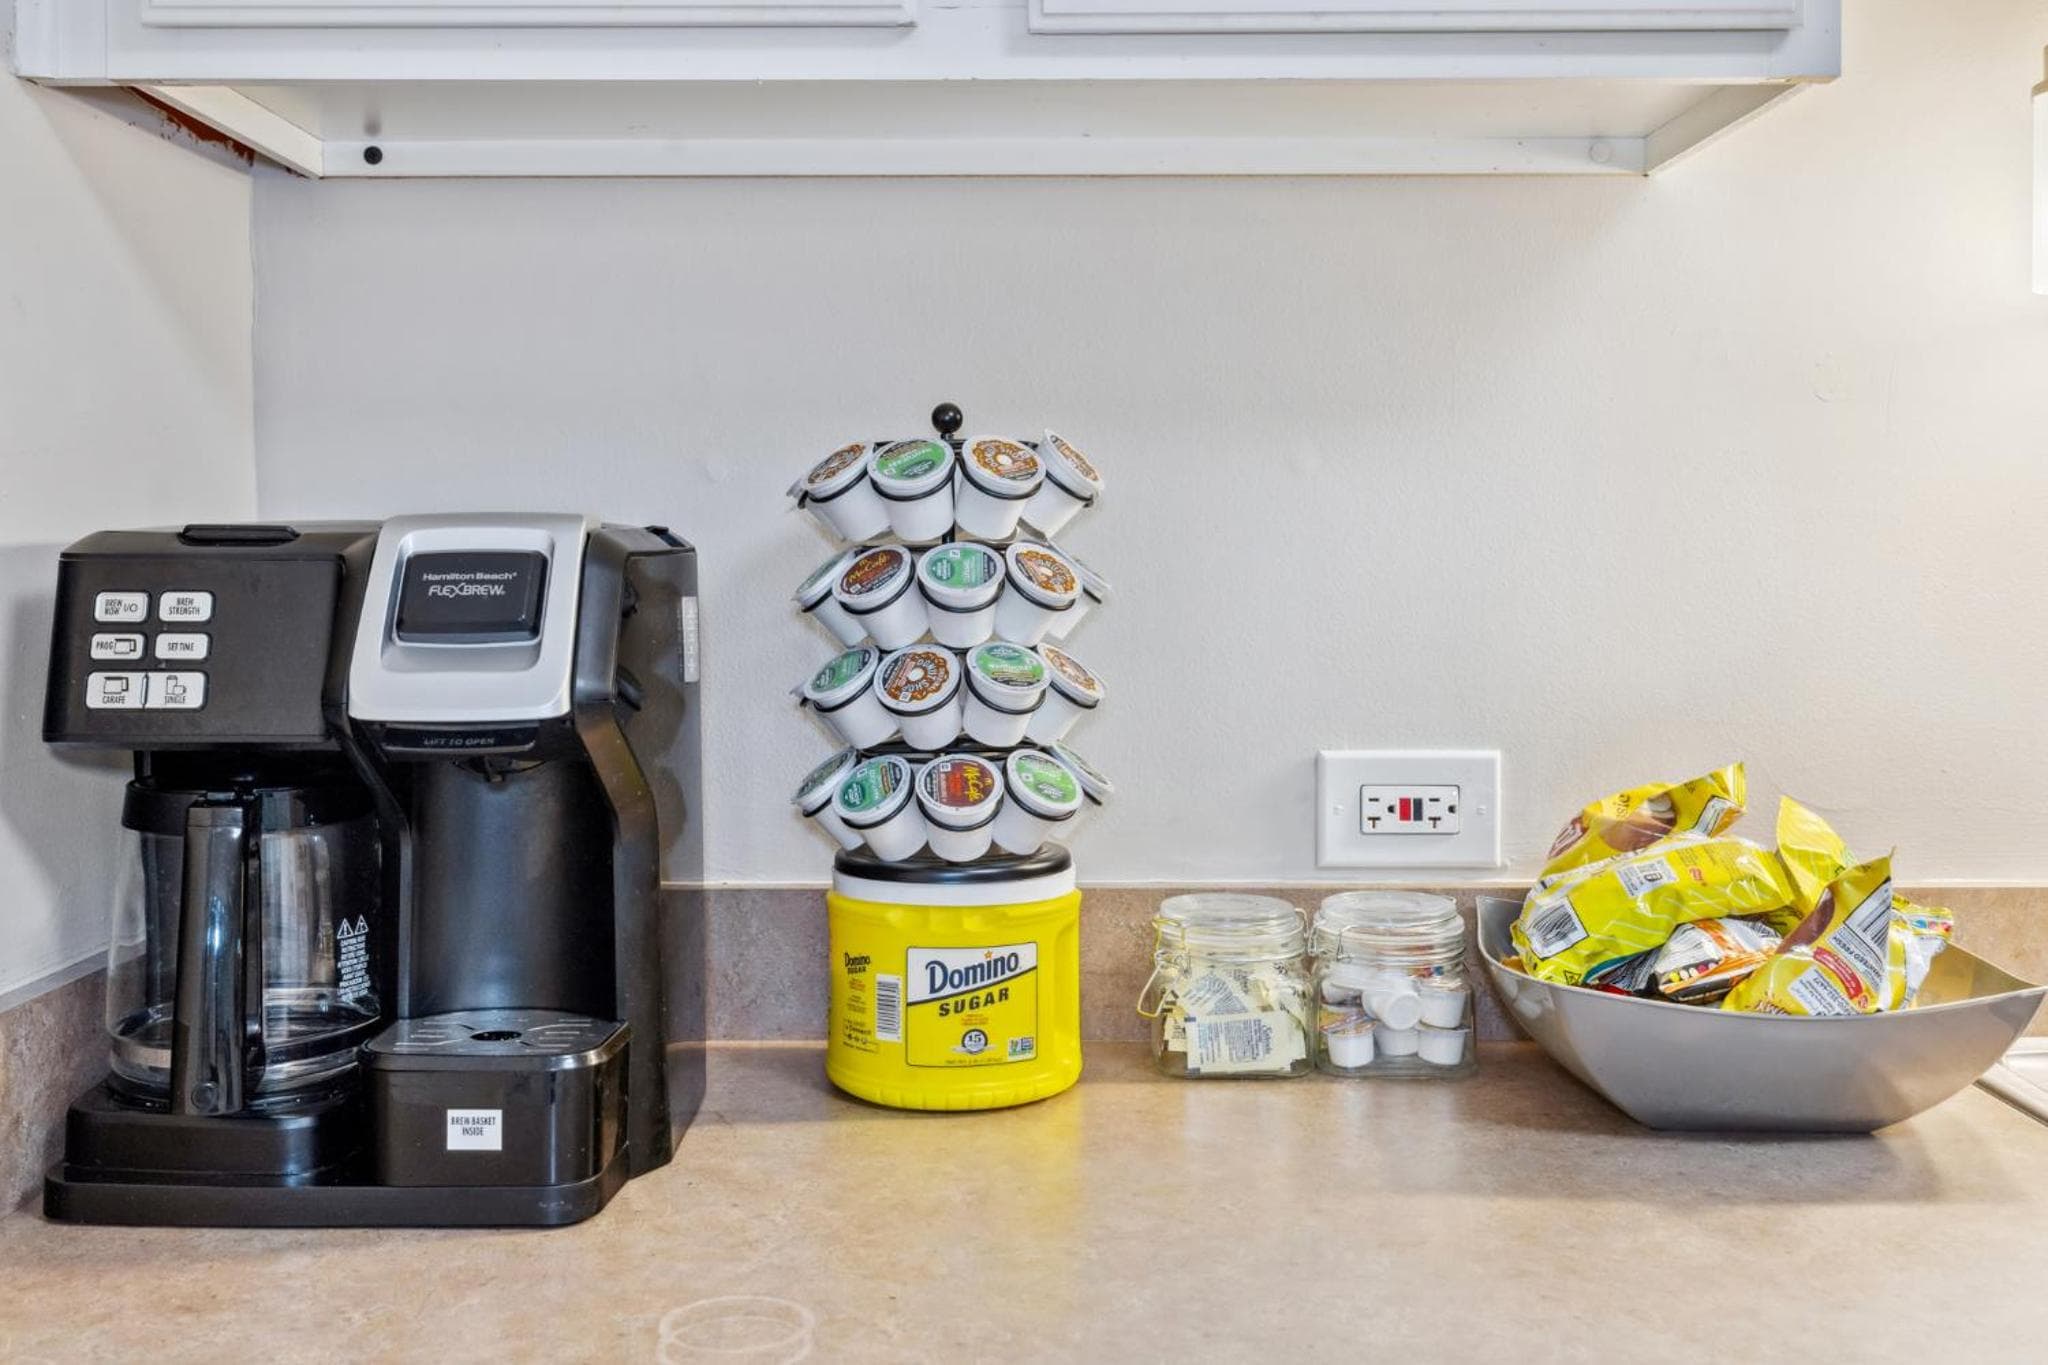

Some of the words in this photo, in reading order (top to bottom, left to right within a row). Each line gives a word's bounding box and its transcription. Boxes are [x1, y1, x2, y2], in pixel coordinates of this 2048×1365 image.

[423, 572, 475, 581] Hamilton
[168, 606, 201, 616] STRENGTH
[102, 695, 126, 705] CARAFE
[845, 952, 871, 967] Domino
[925, 950, 1020, 995] Domino
[938, 986, 1010, 1018] SUGAR
[451, 1116, 470, 1126] BREW
[471, 1116, 496, 1126] BASKET
[462, 1126, 484, 1137] INSIDE
